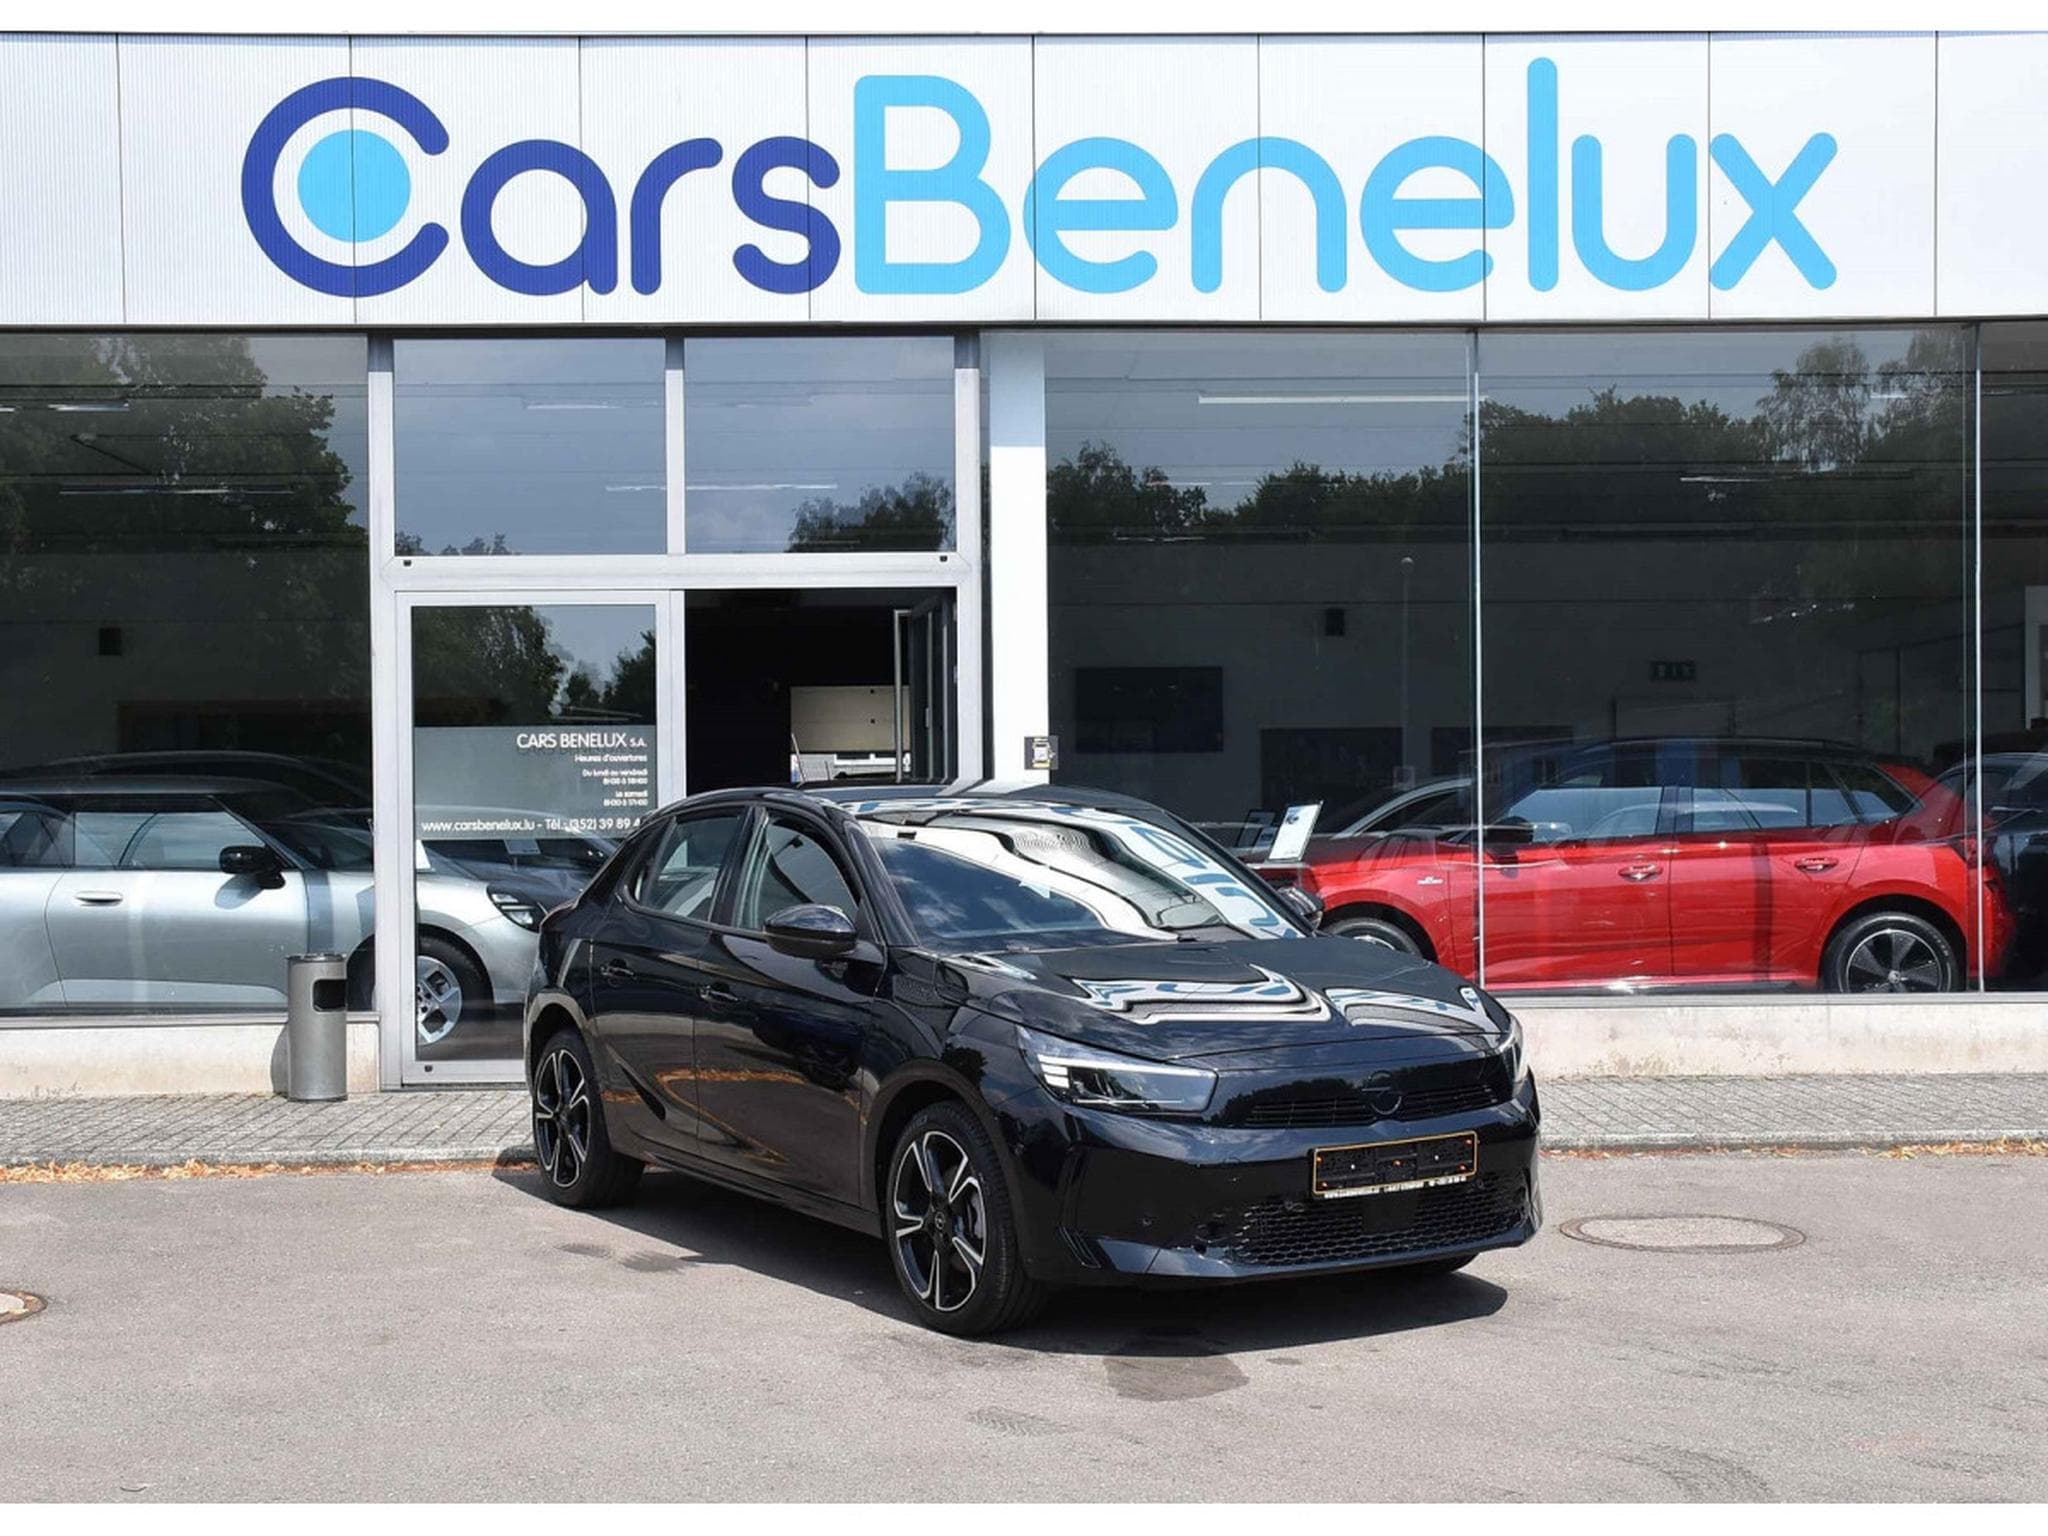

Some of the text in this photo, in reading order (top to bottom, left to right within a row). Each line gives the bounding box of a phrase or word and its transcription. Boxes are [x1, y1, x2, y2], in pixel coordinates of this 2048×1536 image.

[242, 58, 1836, 296] CarsBenelux
[516, 733, 647, 748] CARS BENELUX S.A.
[574, 754, 601, 763] Heures
[582, 768, 592, 777] Du
[593, 768, 609, 777] lundi
[619, 768, 648, 777] vendredi
[615, 790, 648, 798] Le samedi
[420, 819, 535, 832] www.carsbenelux.lu
[598, 817, 613, 830] 39
[615, 817, 631, 830] 89
